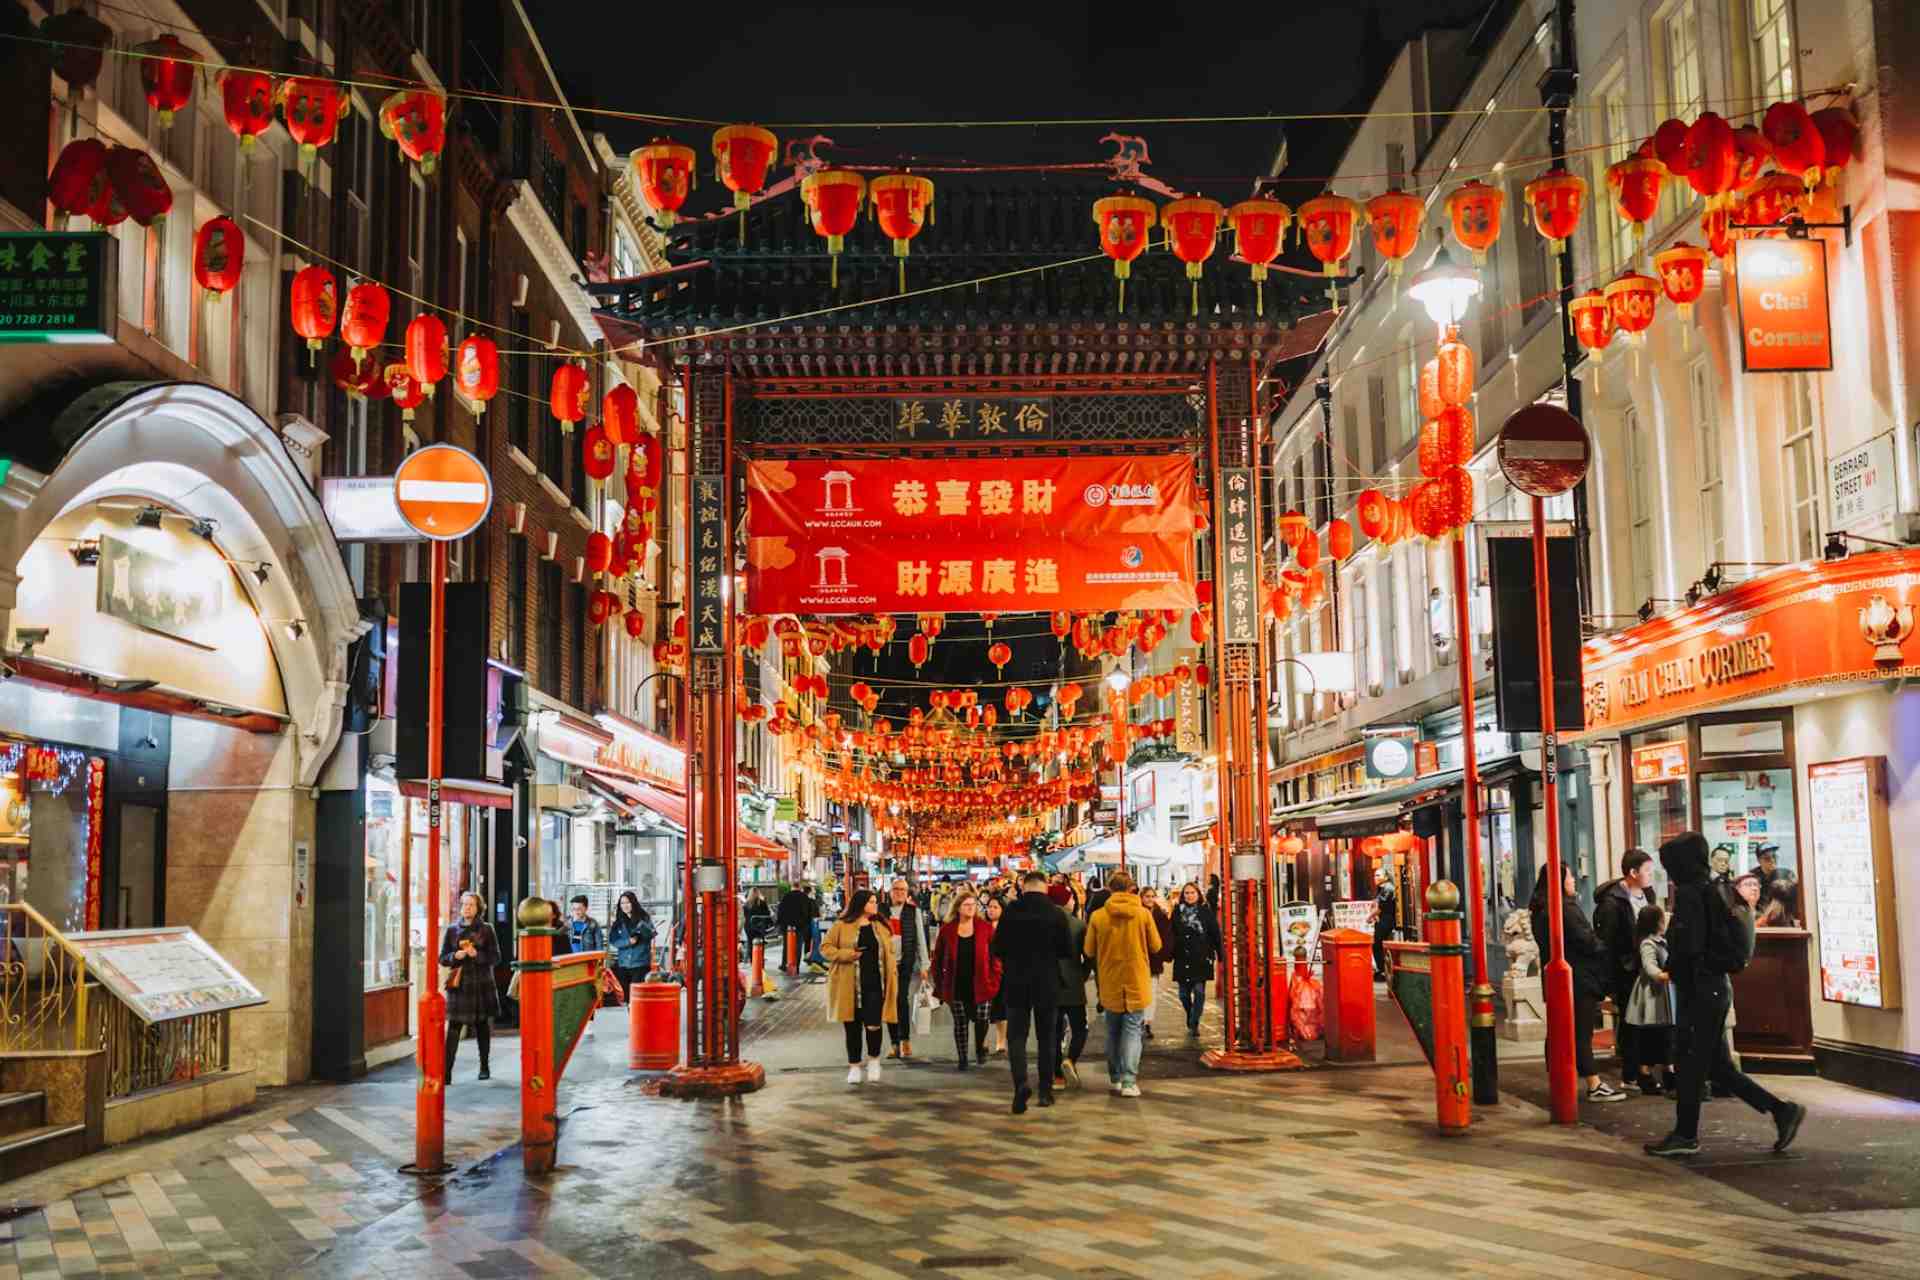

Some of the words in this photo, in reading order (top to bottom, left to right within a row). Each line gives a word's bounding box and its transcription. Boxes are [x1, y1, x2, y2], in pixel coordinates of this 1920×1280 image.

[16, 314, 44, 325] 7287
[1834, 451, 1869, 481] GERRARD
[892, 479, 1057, 516] 恭喜發財
[1835, 474, 1862, 500] STREET
[1864, 467, 1877, 489] W1
[804, 519, 882, 528] WWW.LCCAUK.COM
[896, 557, 1060, 597] 財源廣進
[1653, 658, 1695, 698] CHAI
[1699, 633, 1775, 686] CORNER
